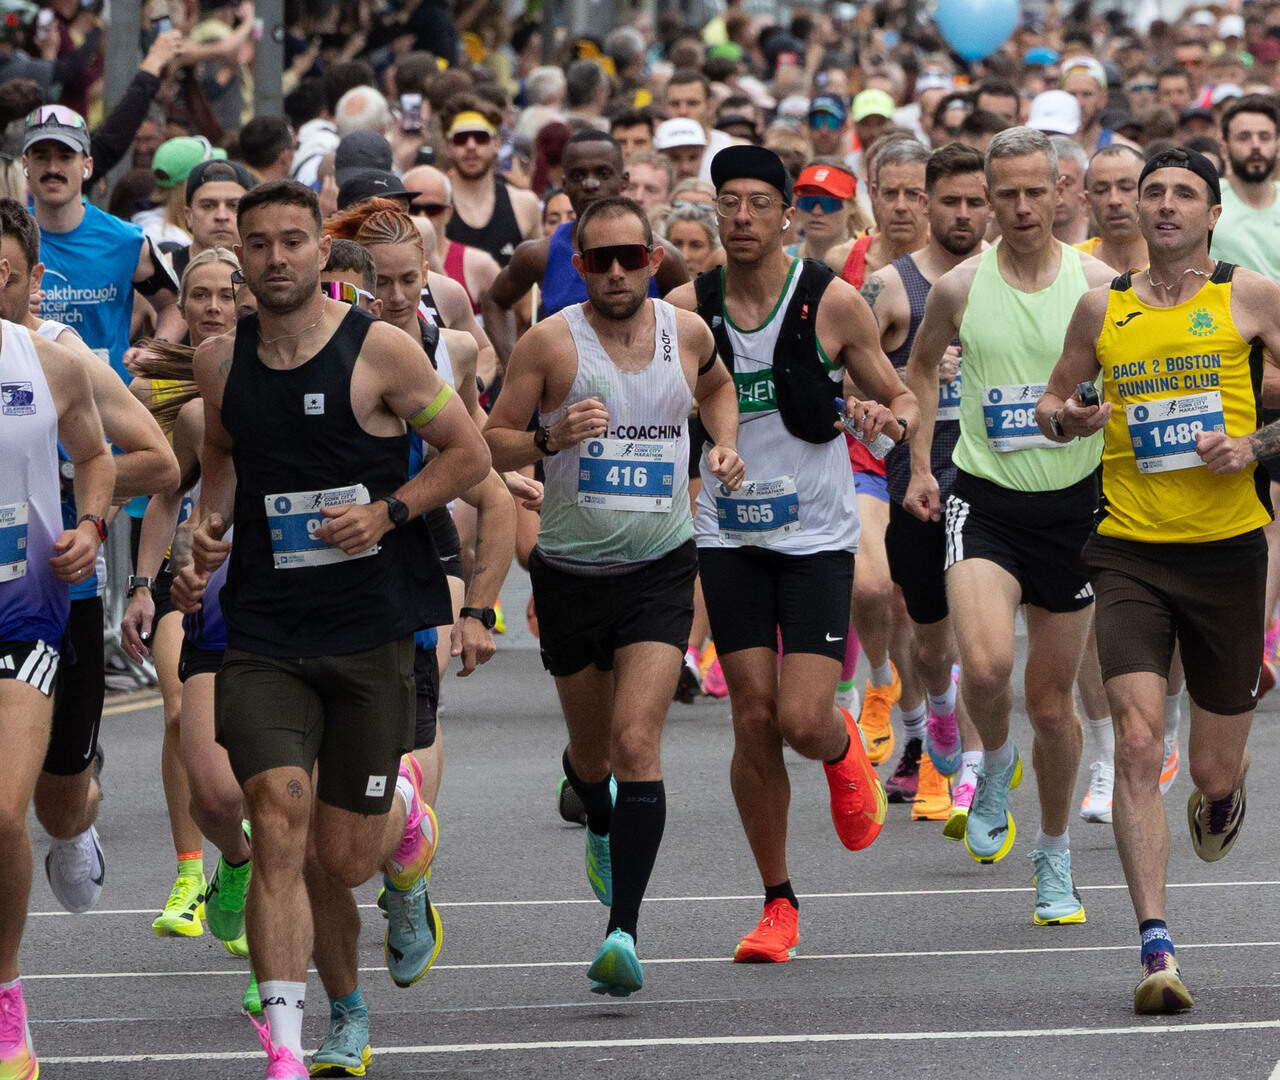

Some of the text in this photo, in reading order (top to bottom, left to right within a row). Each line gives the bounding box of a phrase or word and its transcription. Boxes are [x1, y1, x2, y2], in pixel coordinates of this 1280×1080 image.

[43, 283, 117, 302] akthrough
[662, 329, 671, 362] soar
[1113, 353, 1221, 379] BACK 2 BOSTON
[1118, 373, 1220, 398] RUNNING CLUB
[1150, 420, 1204, 448] 1488
[605, 465, 648, 487] 416
[325, 498, 357, 506] MARATHON
[736, 504, 774, 524] 565
